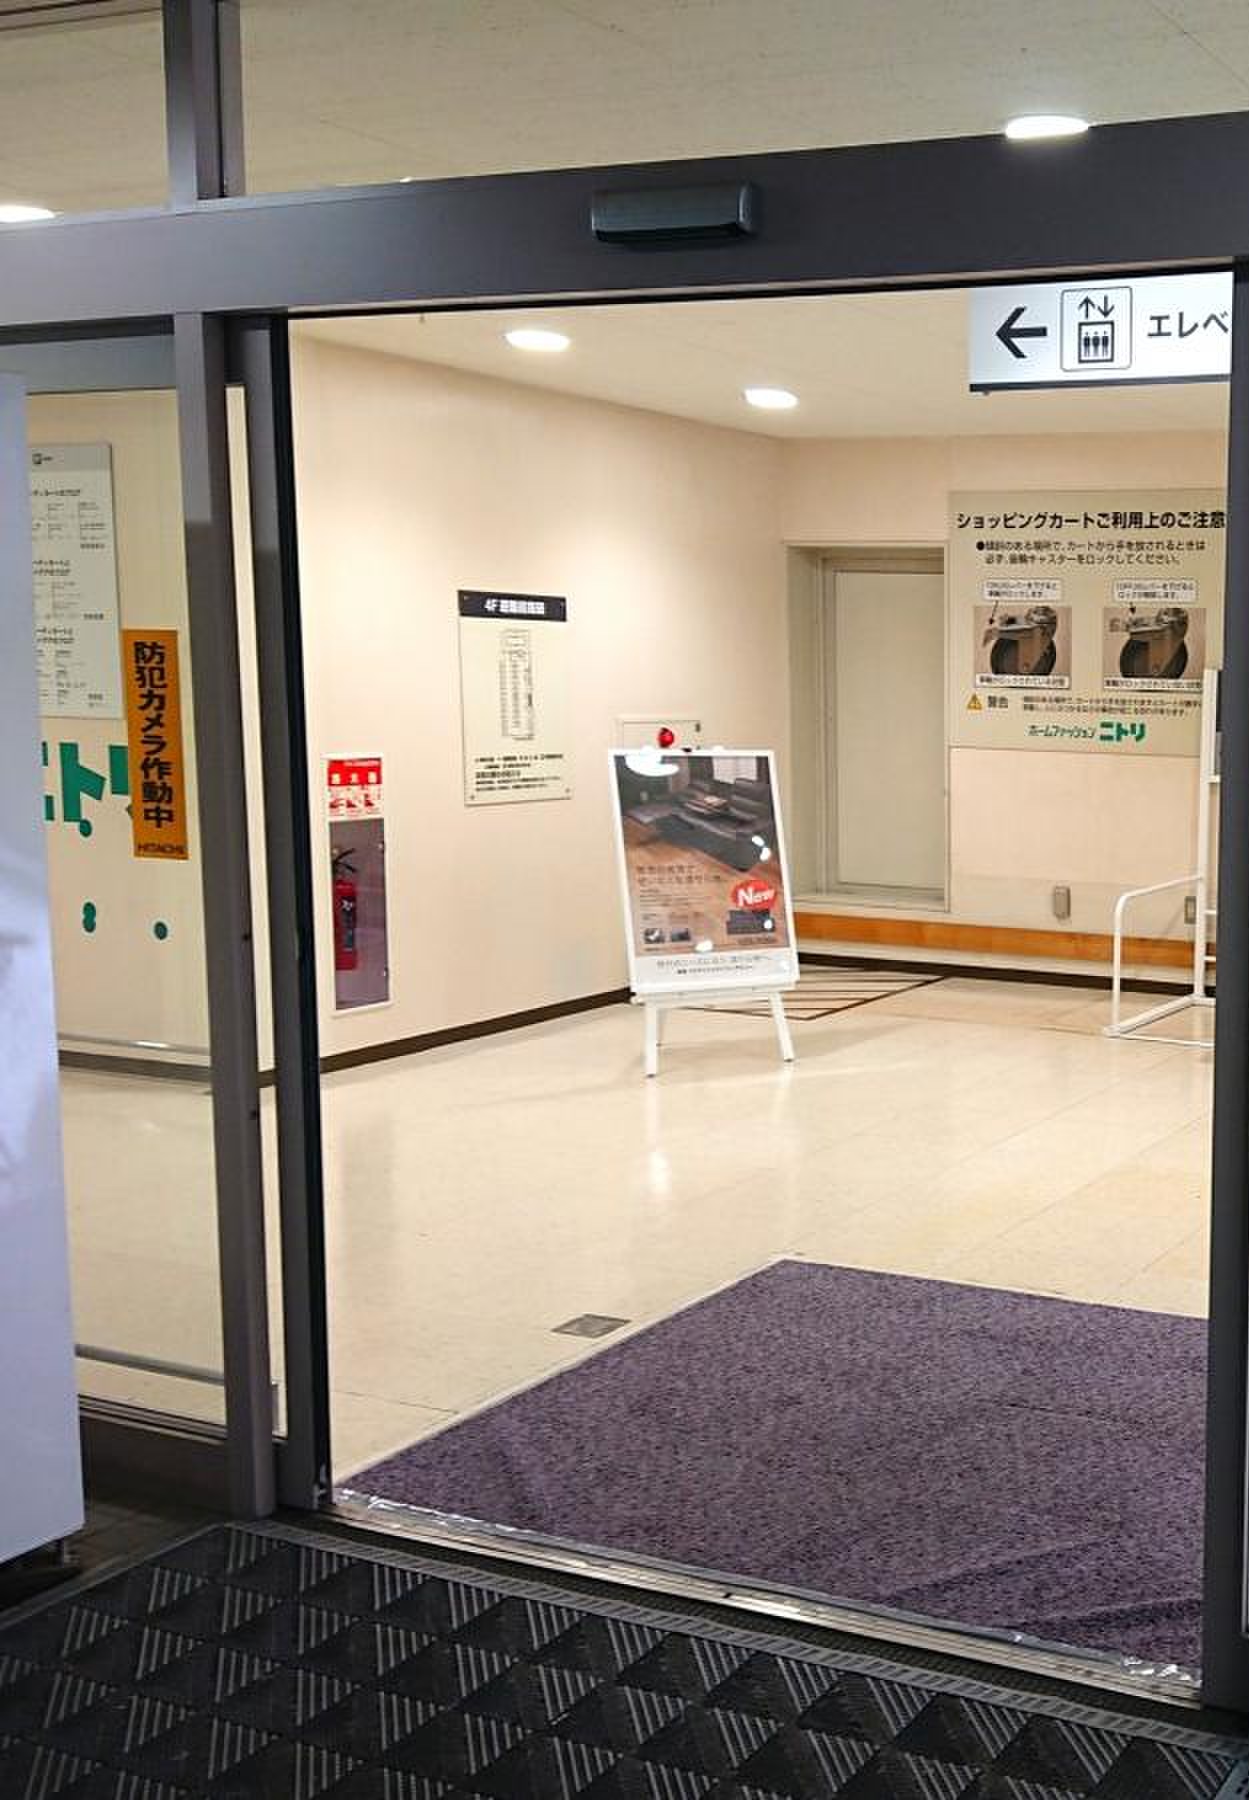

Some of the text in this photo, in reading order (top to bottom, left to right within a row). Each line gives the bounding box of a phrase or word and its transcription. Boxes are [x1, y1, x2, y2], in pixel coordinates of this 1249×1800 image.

[134, 641, 174, 828] 防犯カメラ作動中
[1099, 721, 1146, 742] ニトリ
